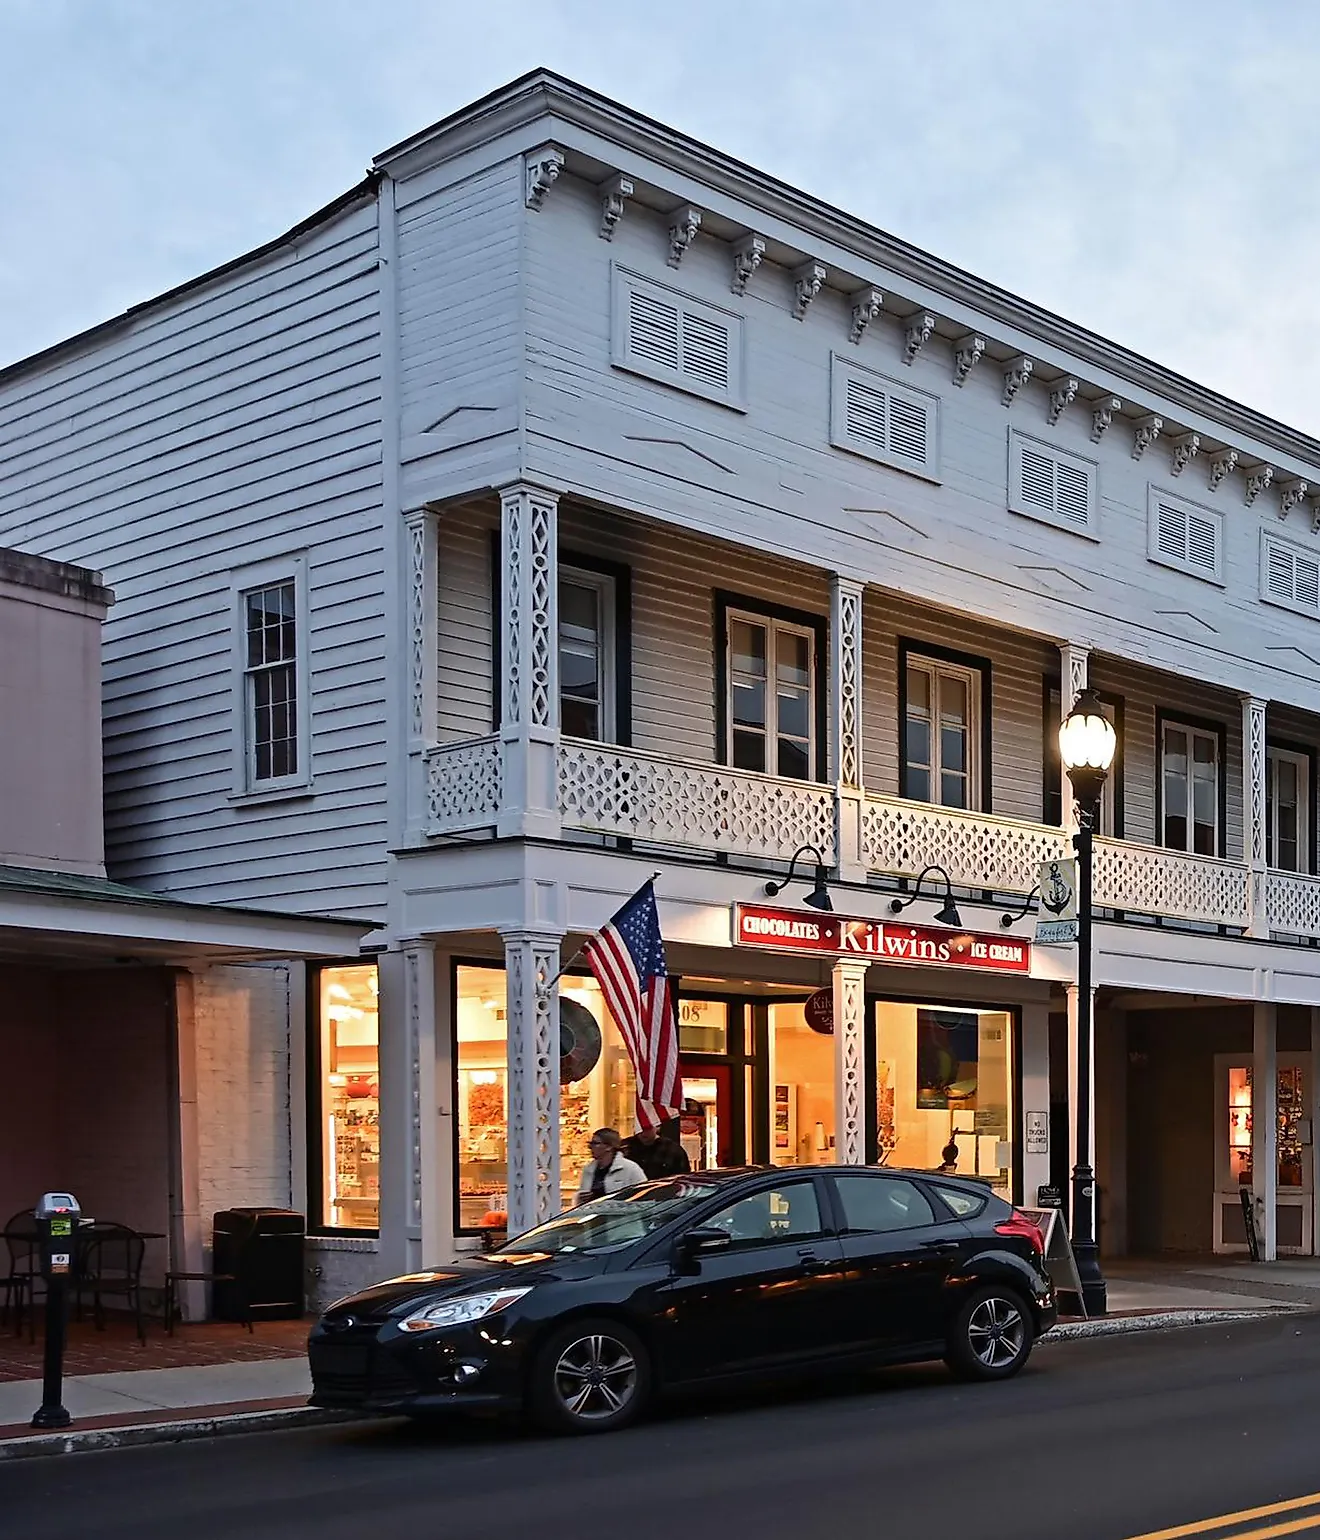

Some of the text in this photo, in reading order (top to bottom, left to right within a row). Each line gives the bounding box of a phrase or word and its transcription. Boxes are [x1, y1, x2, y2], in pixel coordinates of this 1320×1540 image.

[743, 915, 1023, 962] CHOCOLATES Kilwins ICE CREAM
